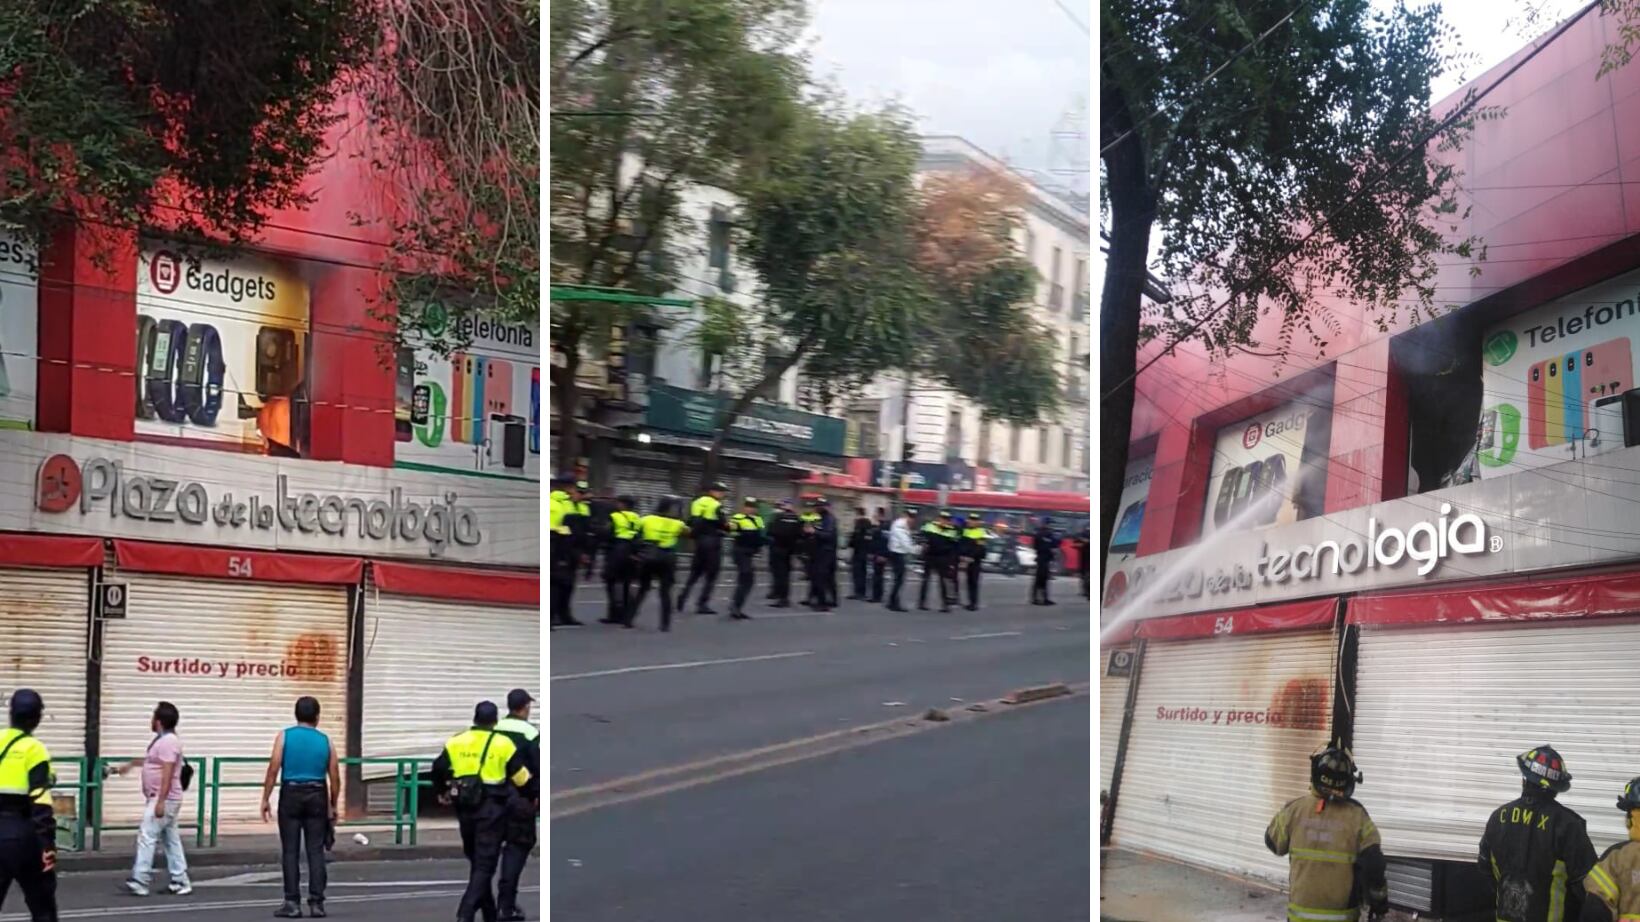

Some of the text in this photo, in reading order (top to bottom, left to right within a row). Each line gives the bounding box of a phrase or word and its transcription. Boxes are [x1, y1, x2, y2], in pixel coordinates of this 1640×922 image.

[186, 264, 276, 302] Gadgets
[82, 456, 209, 525] Plaza
[212, 493, 247, 528] de
[249, 495, 275, 530] la
[228, 556, 253, 577] 54
[1213, 616, 1234, 634] 54
[137, 656, 298, 678] Surtido y precio
[1155, 706, 1208, 722] Surtido
[1213, 709, 1223, 725] y
[1500, 806, 1550, 830] CDMX
